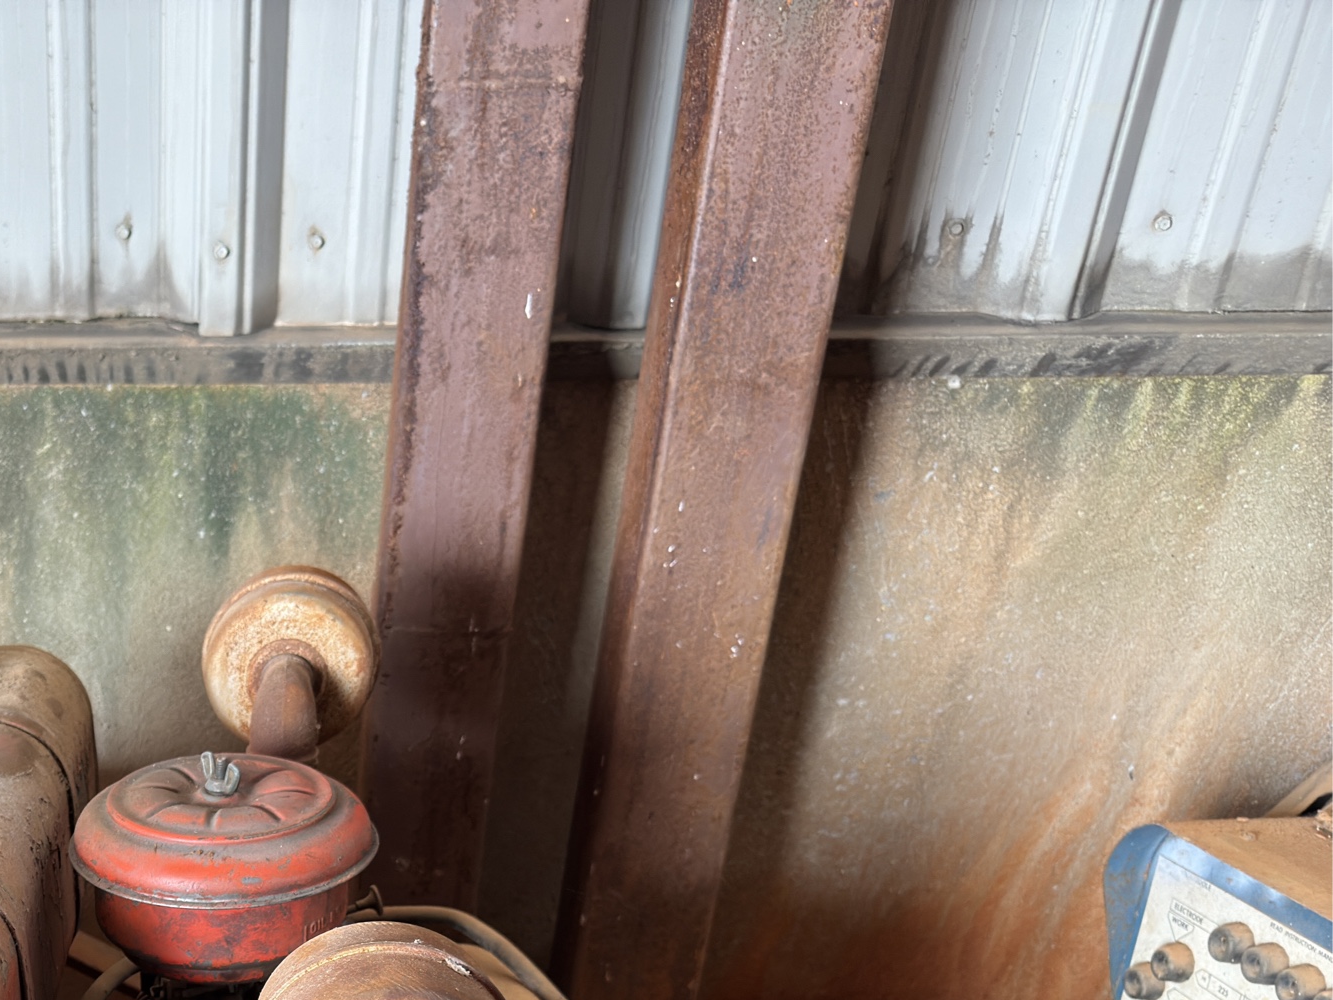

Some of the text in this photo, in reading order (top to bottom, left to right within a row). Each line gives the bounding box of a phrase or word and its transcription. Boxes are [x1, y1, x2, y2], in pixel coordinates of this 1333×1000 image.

[1174, 902, 1203, 925] ELECTRODE
[1172, 916, 1189, 932] WORK
[1218, 986, 1229, 997] 225
